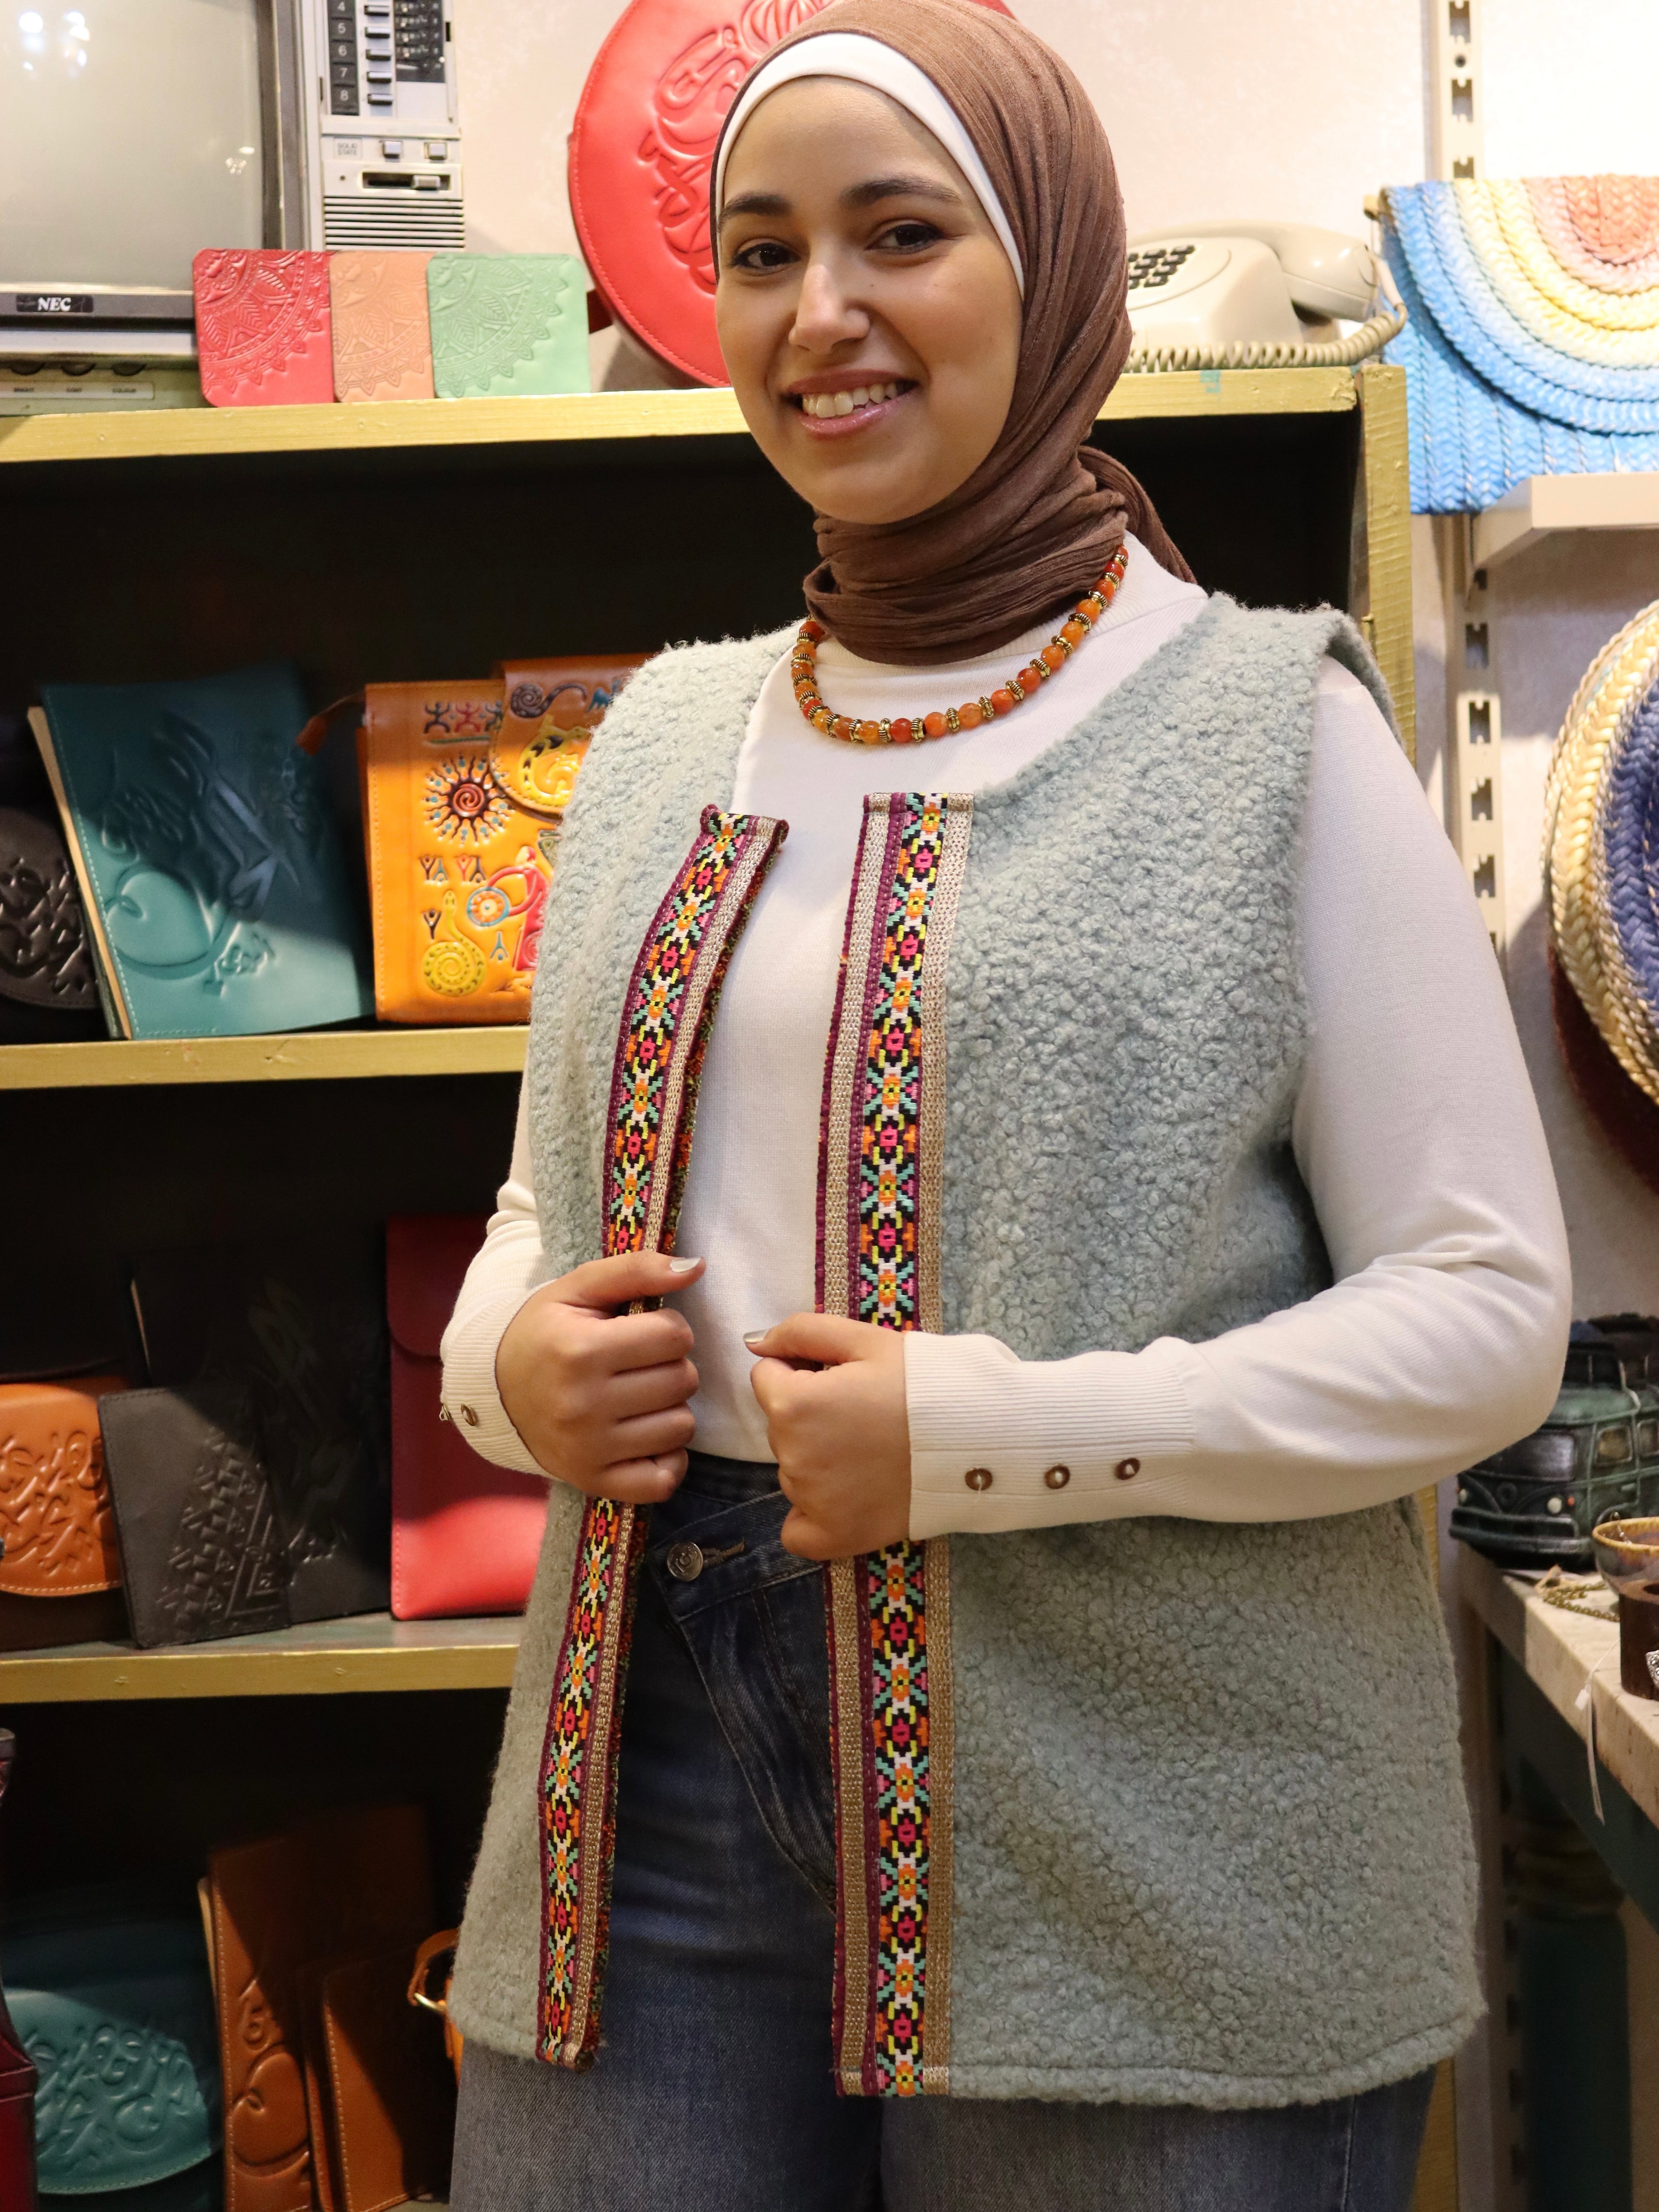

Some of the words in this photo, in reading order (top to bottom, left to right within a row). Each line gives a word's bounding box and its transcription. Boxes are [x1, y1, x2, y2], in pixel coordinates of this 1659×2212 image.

[338, 1, 345, 11] 4
[338, 22, 346, 34] 5
[338, 45, 347, 57] 6
[340, 67, 347, 77] 7
[340, 89, 349, 101] 8
[38, 297, 71, 312] NEC
